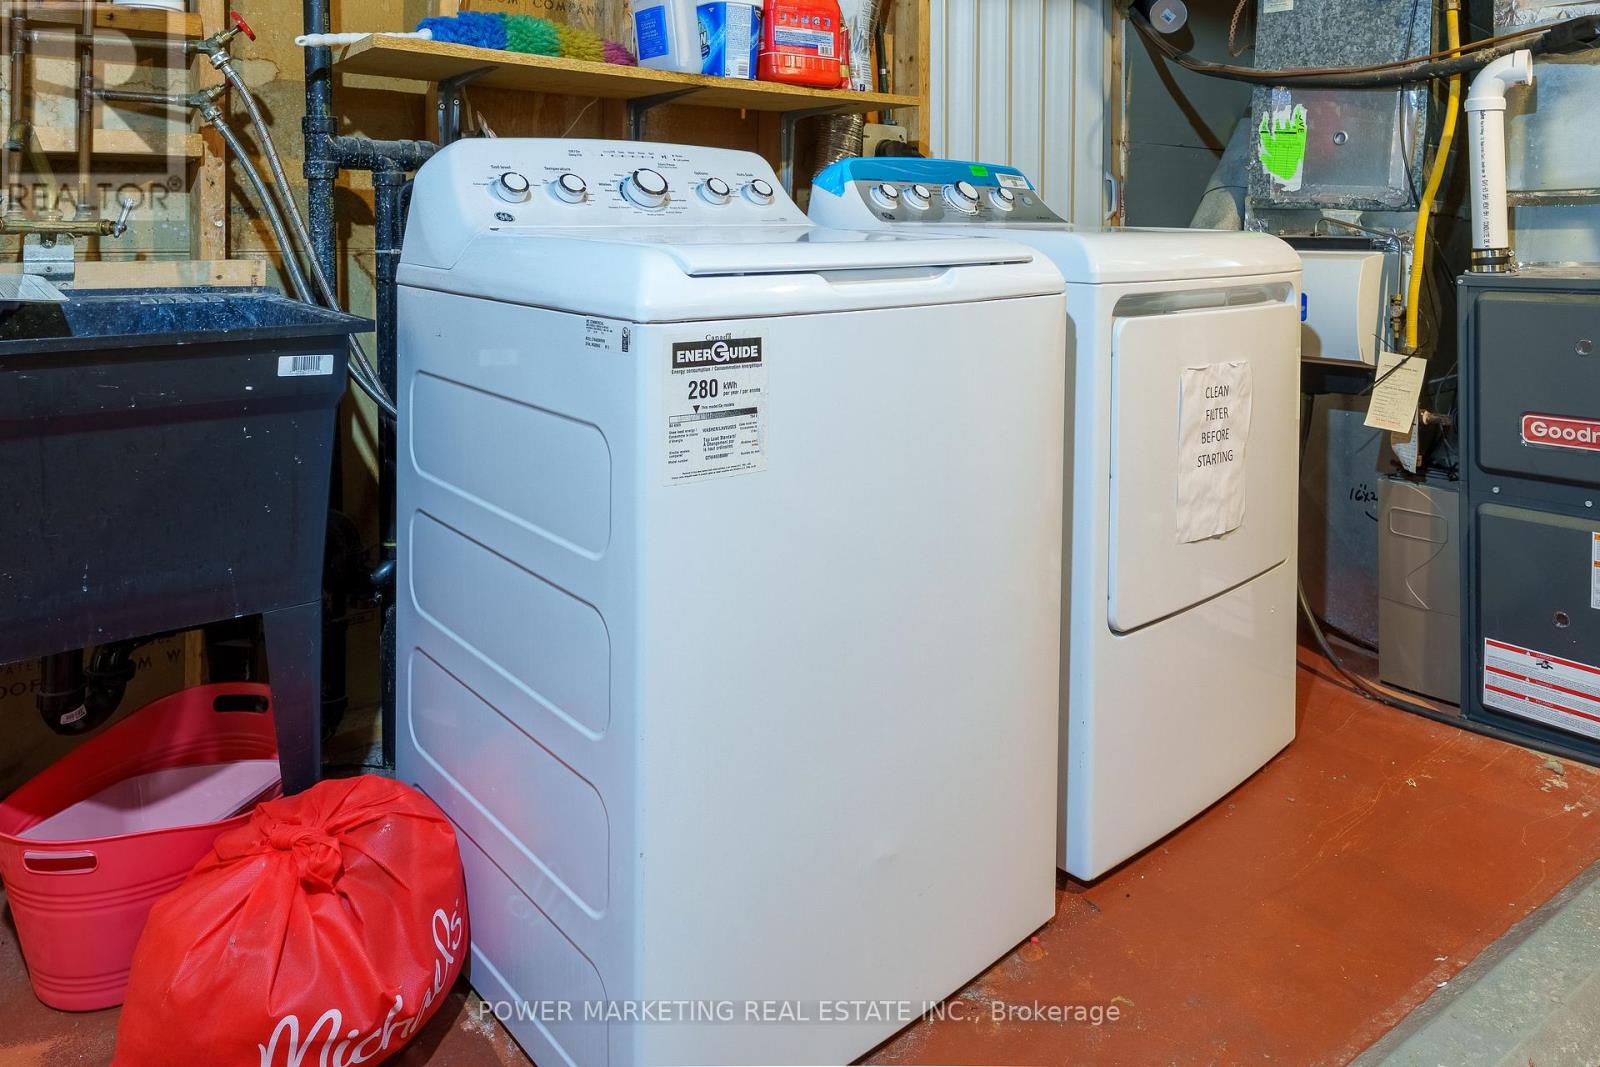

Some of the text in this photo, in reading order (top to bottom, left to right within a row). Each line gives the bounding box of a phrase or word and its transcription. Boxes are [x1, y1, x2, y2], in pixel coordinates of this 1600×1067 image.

[676, 341, 758, 363] ENERGUIDE
[688, 378, 719, 400] 280
[723, 381, 738, 390] kWh
[1205, 384, 1230, 399] CLEAN
[1205, 406, 1229, 422] FILTER
[1201, 428, 1230, 445] BEFORE
[1197, 450, 1234, 468] STARTING
